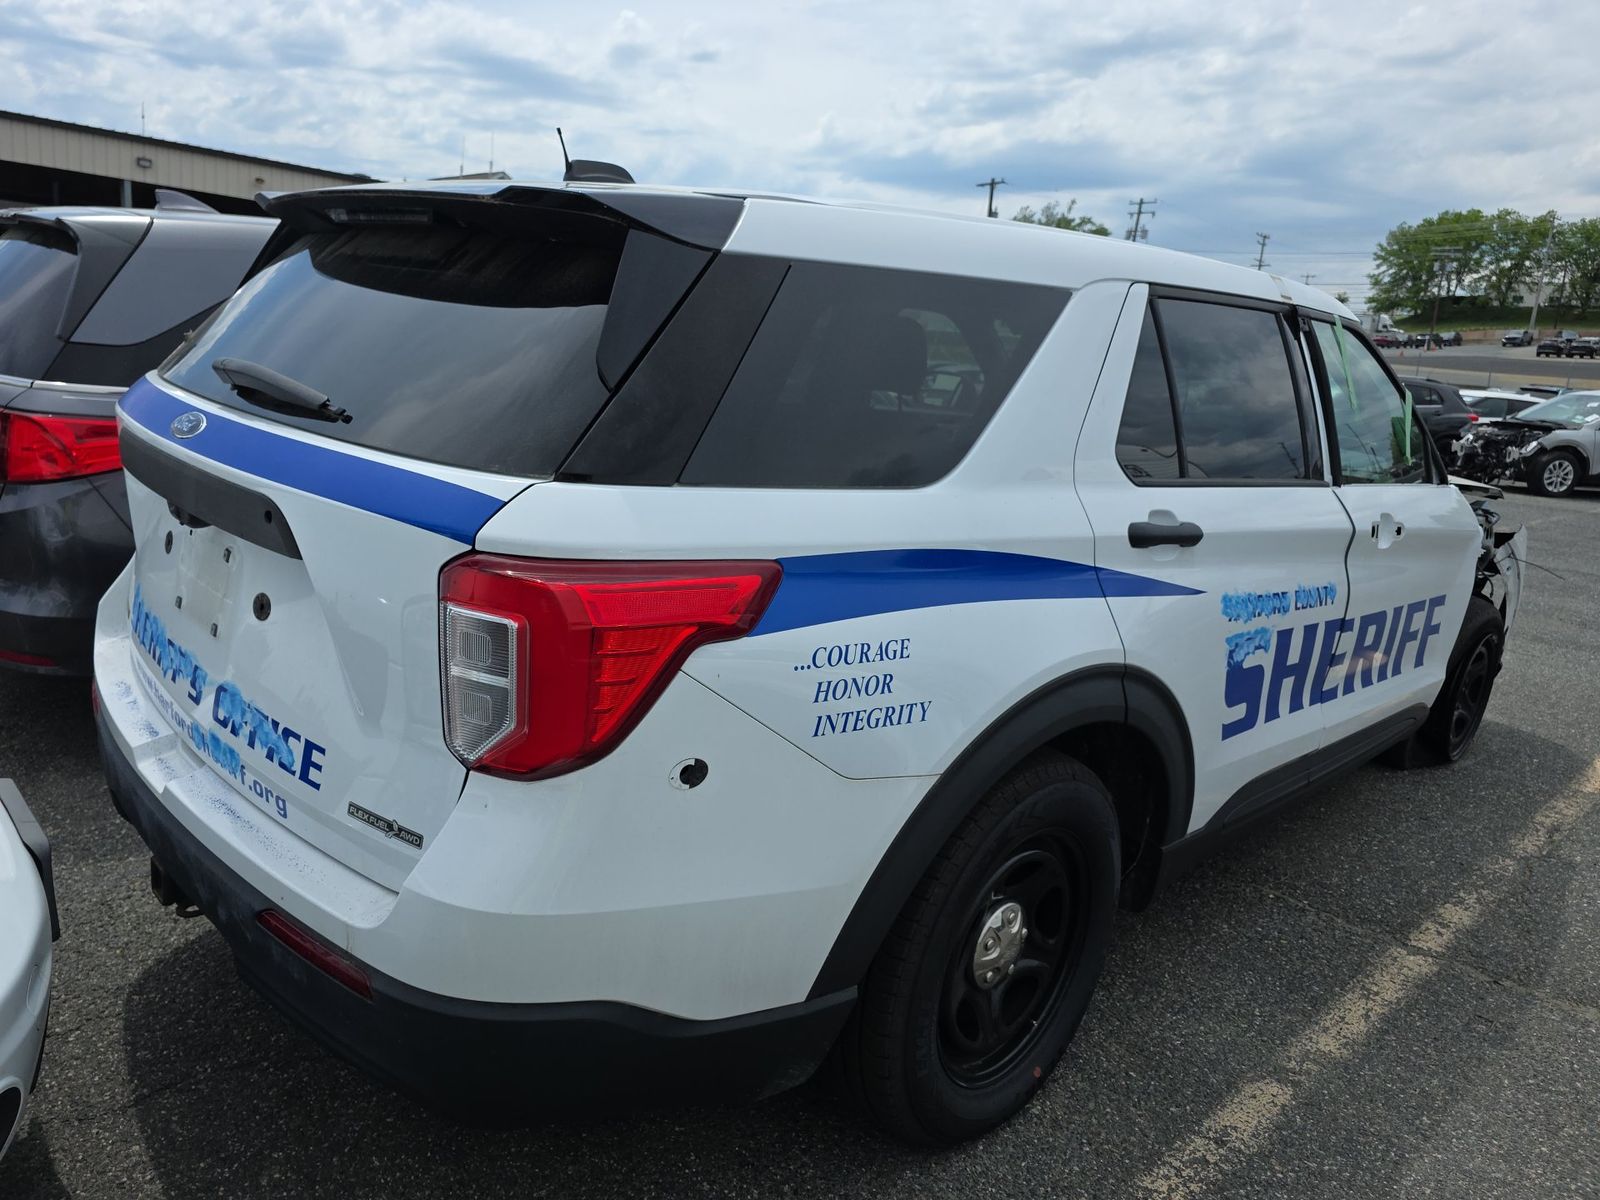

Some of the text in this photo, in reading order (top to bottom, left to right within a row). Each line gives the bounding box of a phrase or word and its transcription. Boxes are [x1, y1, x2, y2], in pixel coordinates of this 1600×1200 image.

[1221, 594, 1447, 742] SHERIFF
[812, 673, 894, 704] HONOR
[811, 700, 933, 738] INTEGRITY
[349, 806, 420, 845] FLEX FUEL AWD
